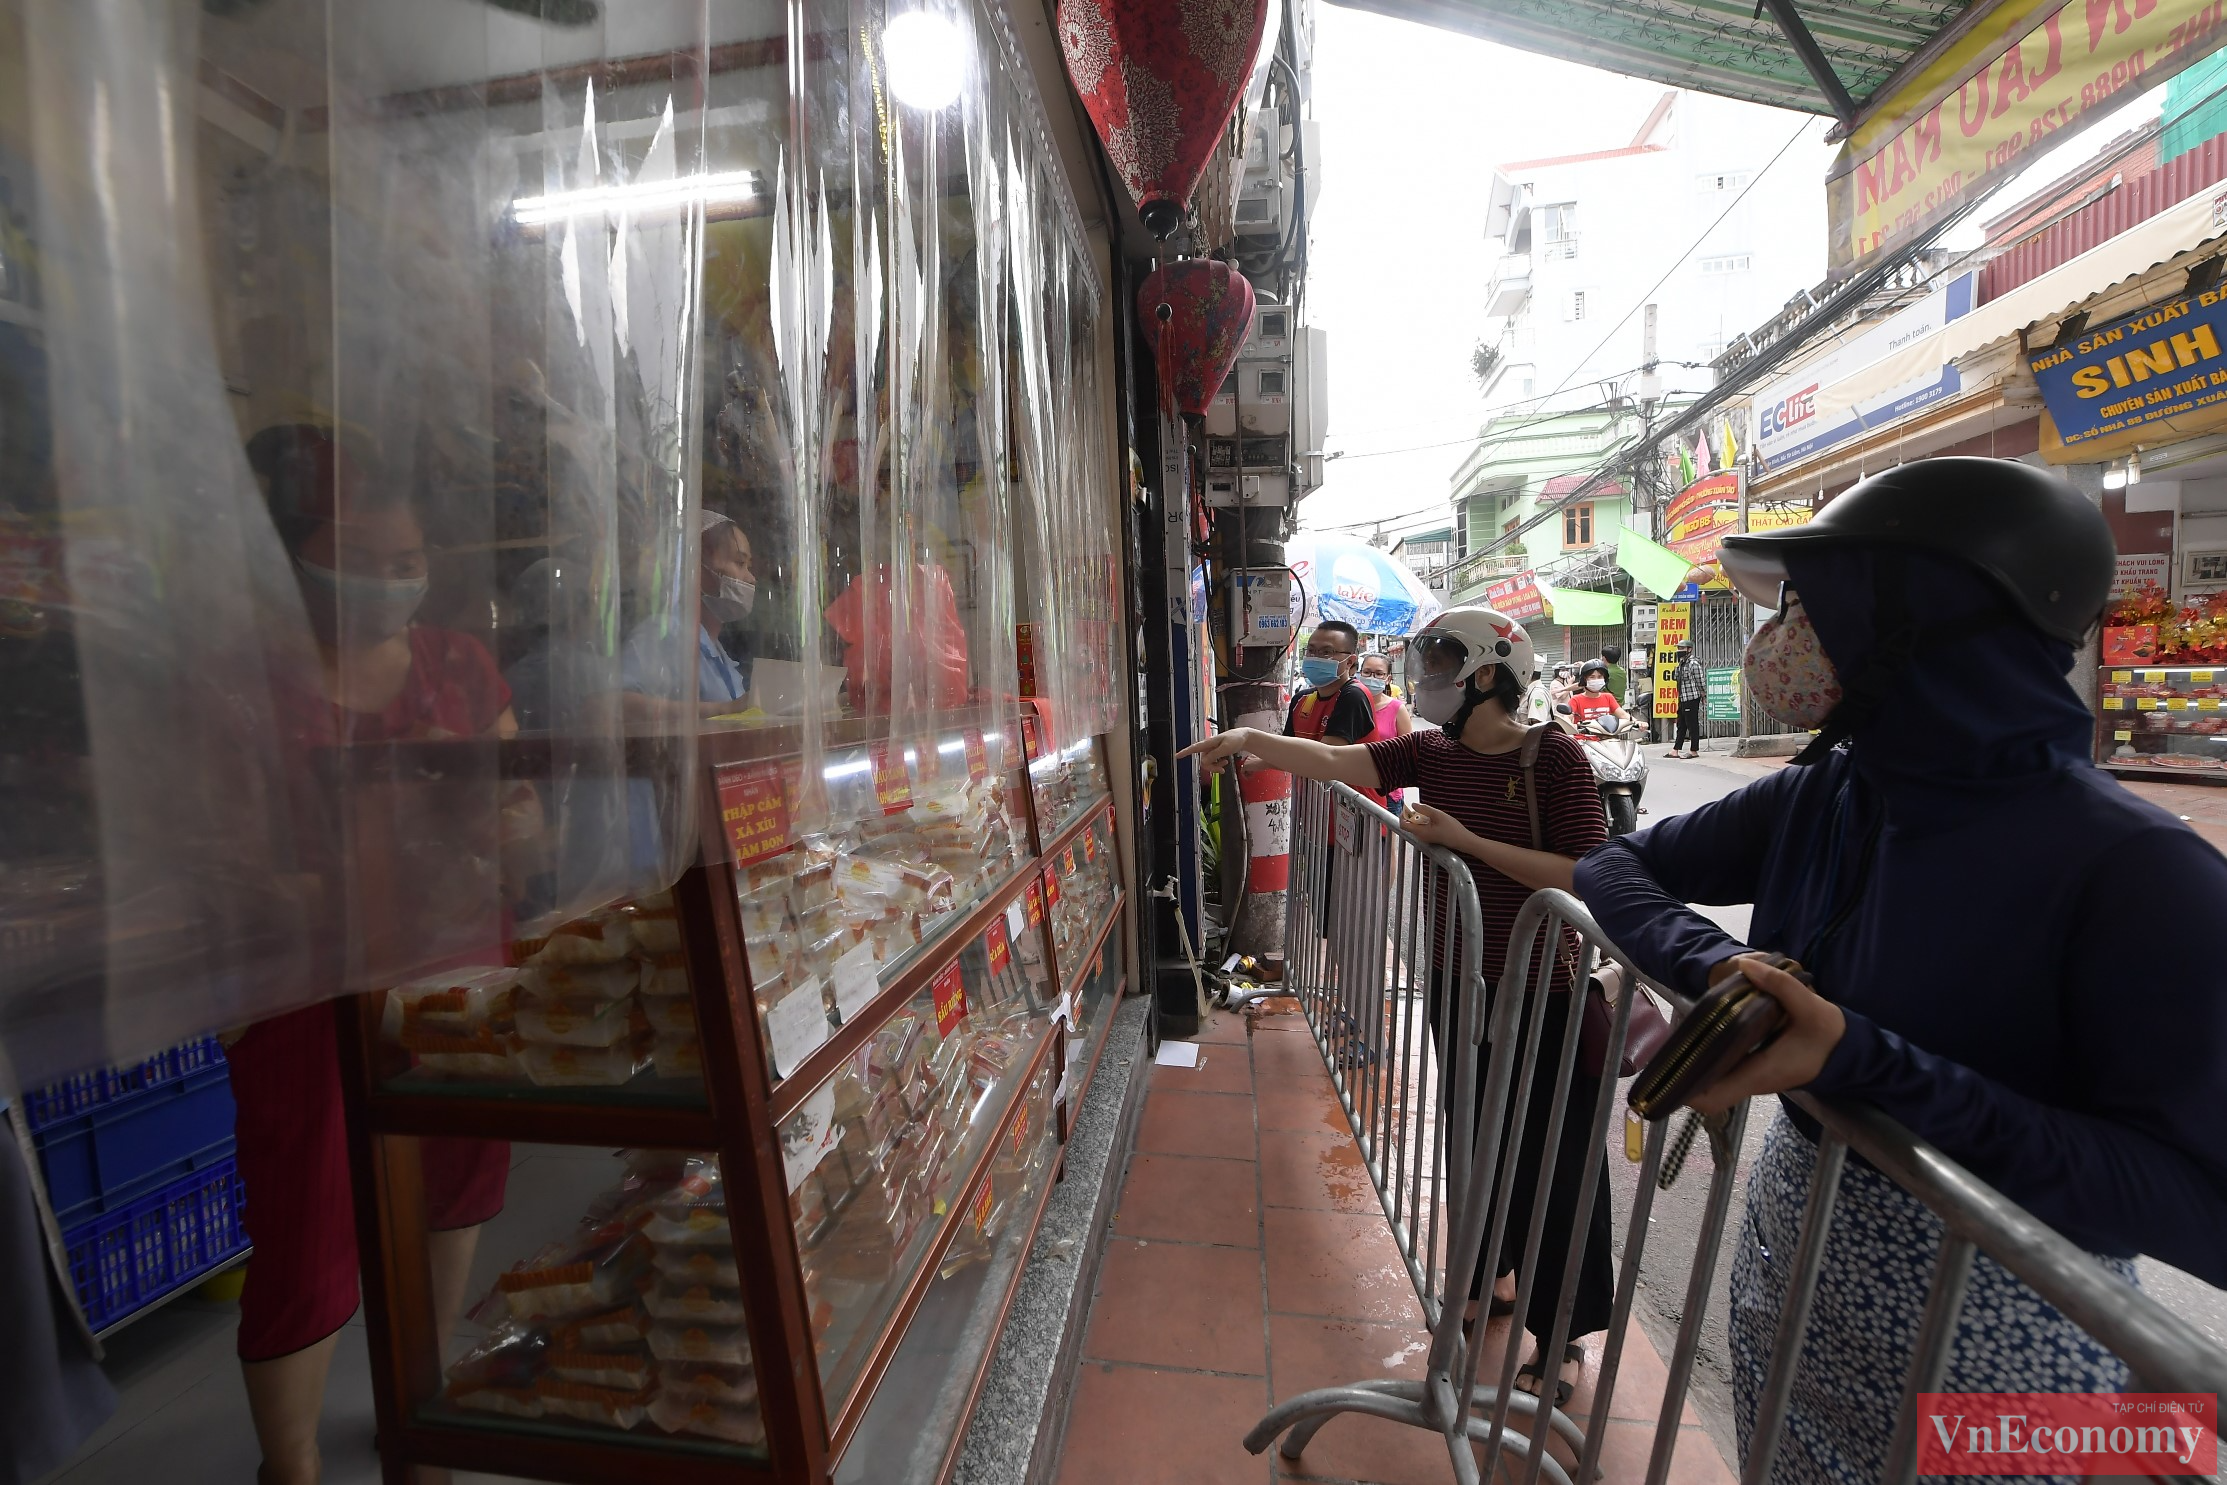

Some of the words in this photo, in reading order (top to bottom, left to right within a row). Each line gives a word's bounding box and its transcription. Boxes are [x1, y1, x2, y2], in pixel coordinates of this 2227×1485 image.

[1889, 332, 1911, 350] Thanh
[2031, 347, 2074, 373] NHÀ
[2078, 328, 2124, 355] SẢN
[2128, 299, 2190, 335] XUẤT
[2071, 323, 2222, 399] SINH
[2100, 393, 2145, 418] CHUYÊN
[2145, 387, 2173, 405] SẢN
[2173, 373, 2208, 396] XUẤT
[1894, 398, 1915, 412] Hotline:
[2100, 419, 2125, 433] NHÀ
[2127, 415, 2142, 425] 88
[2145, 403, 2193, 421] ĐƯỜNG
[2197, 390, 2227, 406] XUÂ
[1751, 516, 1772, 527] THẤT
[1775, 517, 1794, 526] CAO
[1660, 616, 1686, 630] RÈM
[1655, 699, 1677, 714] CUỐ
[755, 817, 777, 833] XÍU
[761, 834, 784, 851] BON
